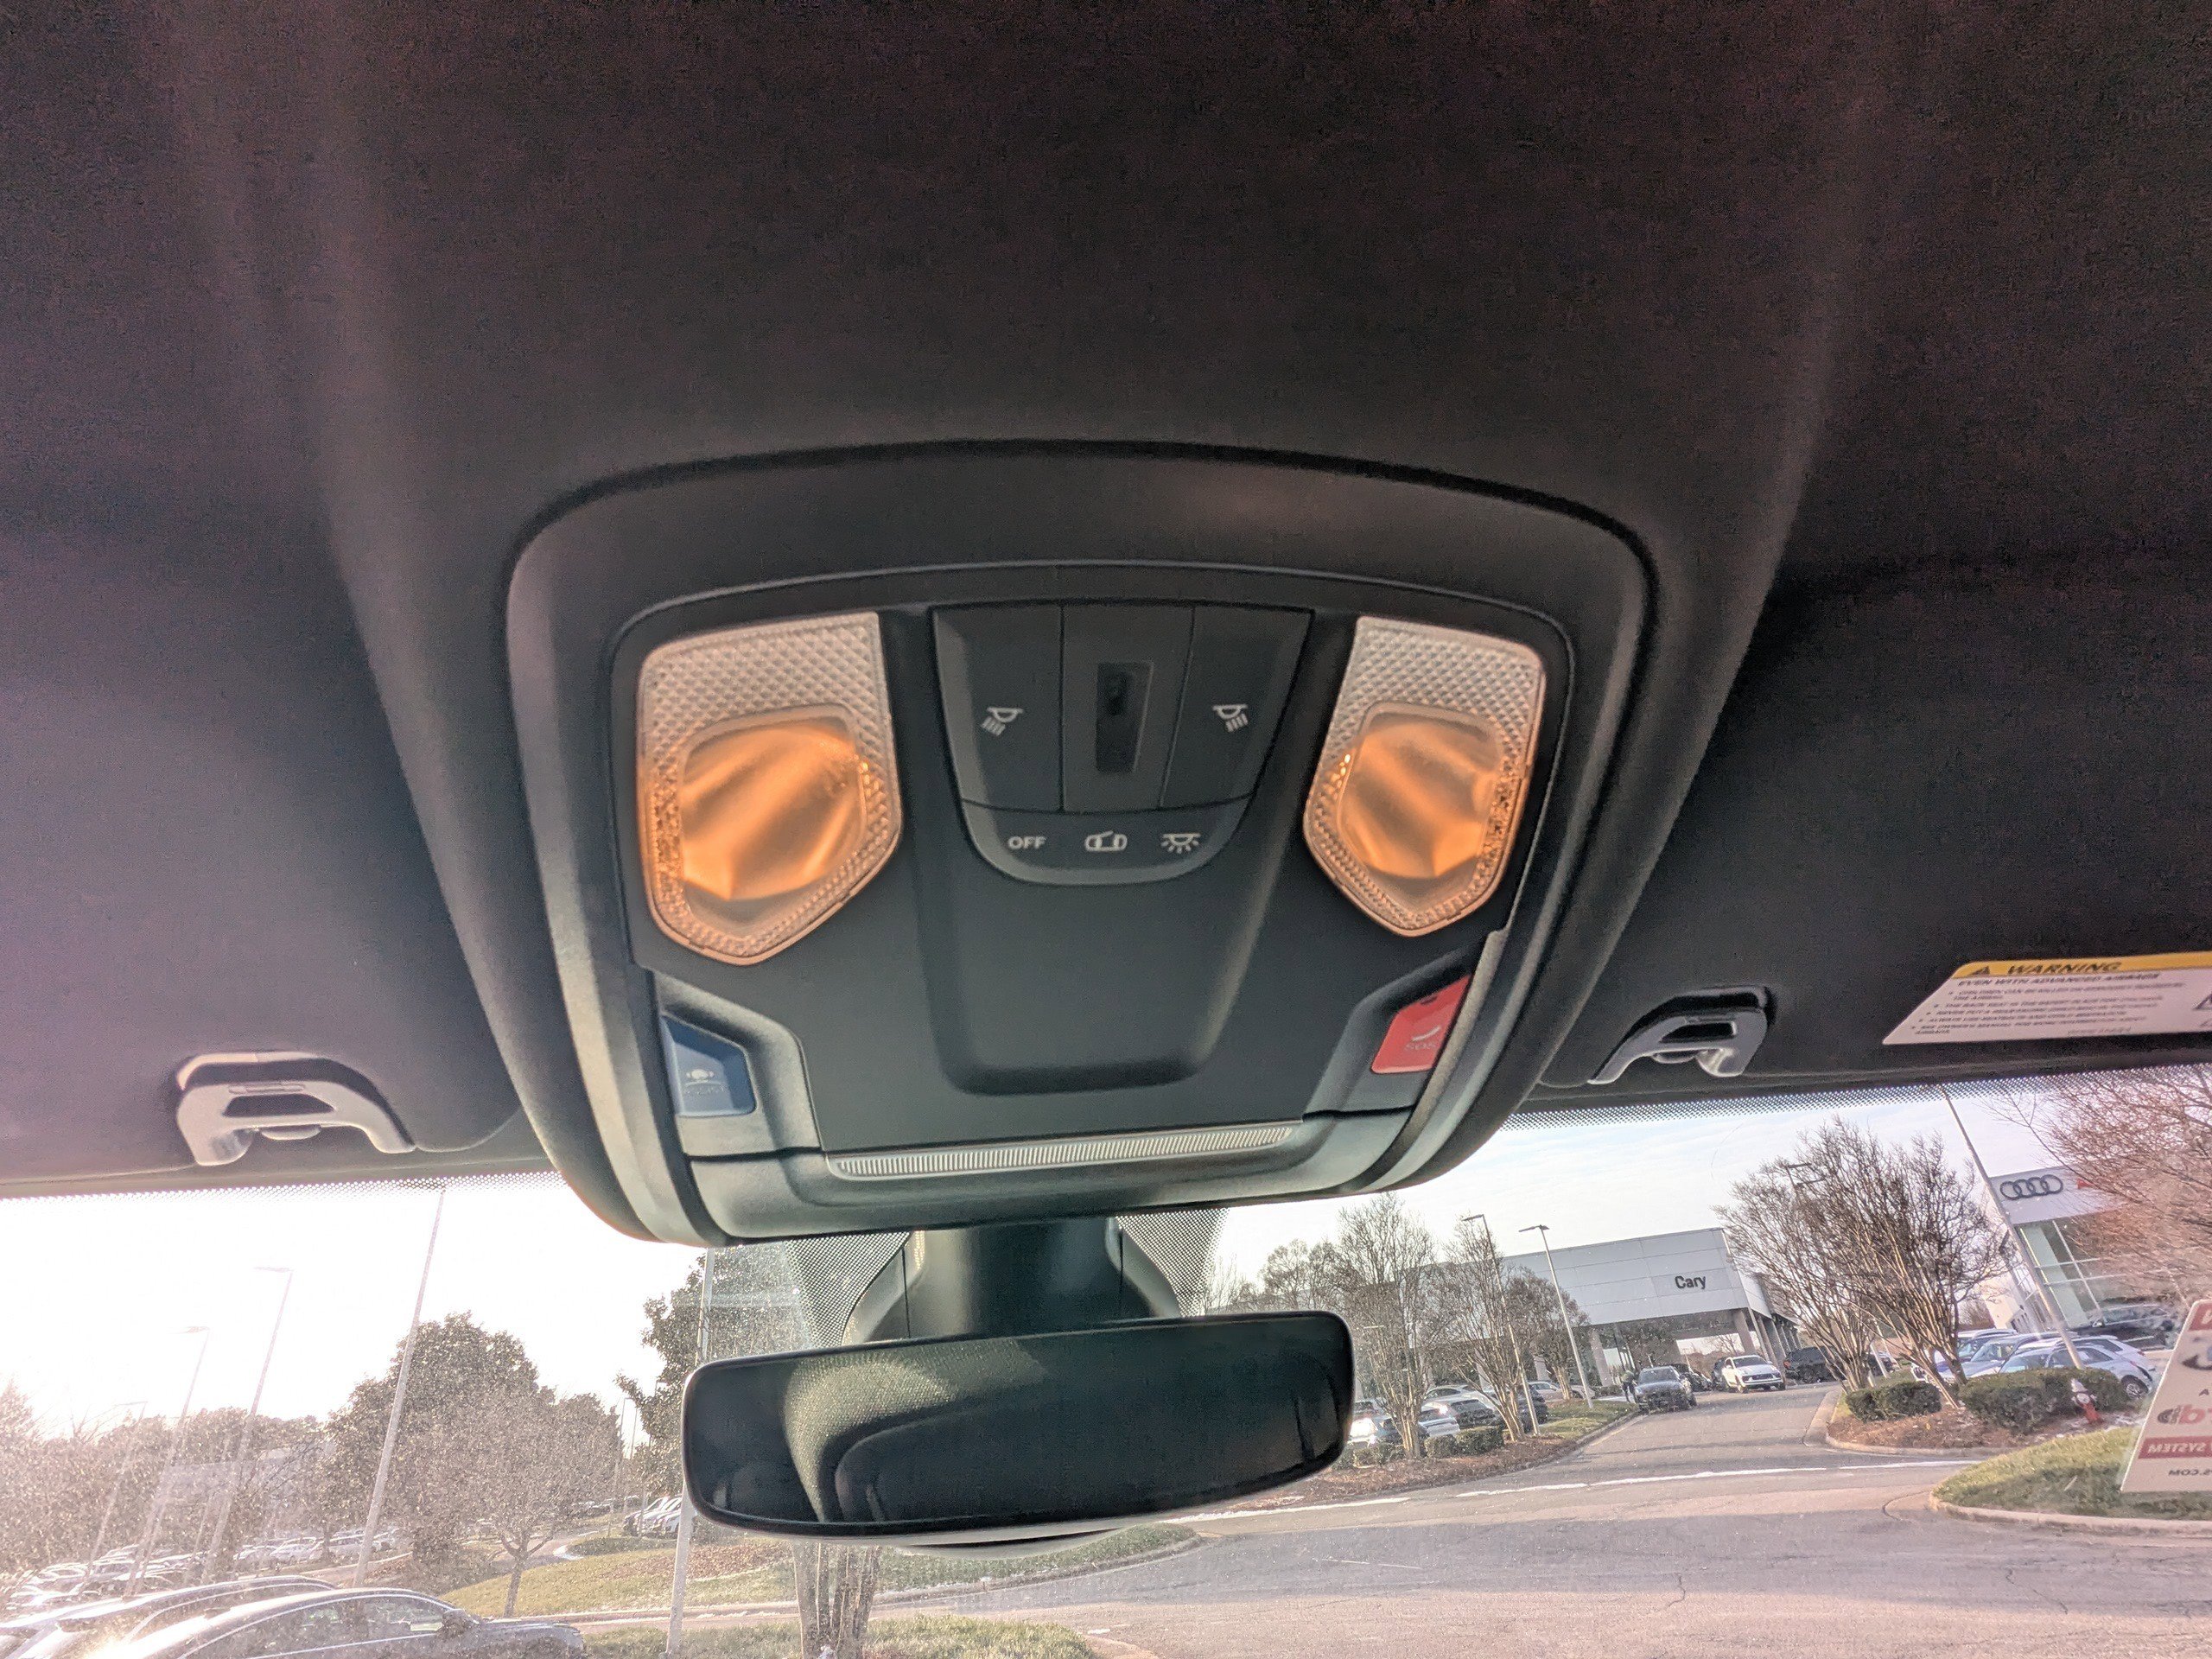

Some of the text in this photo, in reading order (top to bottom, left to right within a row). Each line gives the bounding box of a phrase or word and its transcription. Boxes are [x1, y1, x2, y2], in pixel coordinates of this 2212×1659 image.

[1007, 836, 1047, 850] OFF
[2006, 961, 2122, 975] WARNING
[1675, 1275, 1707, 1290] Cary
